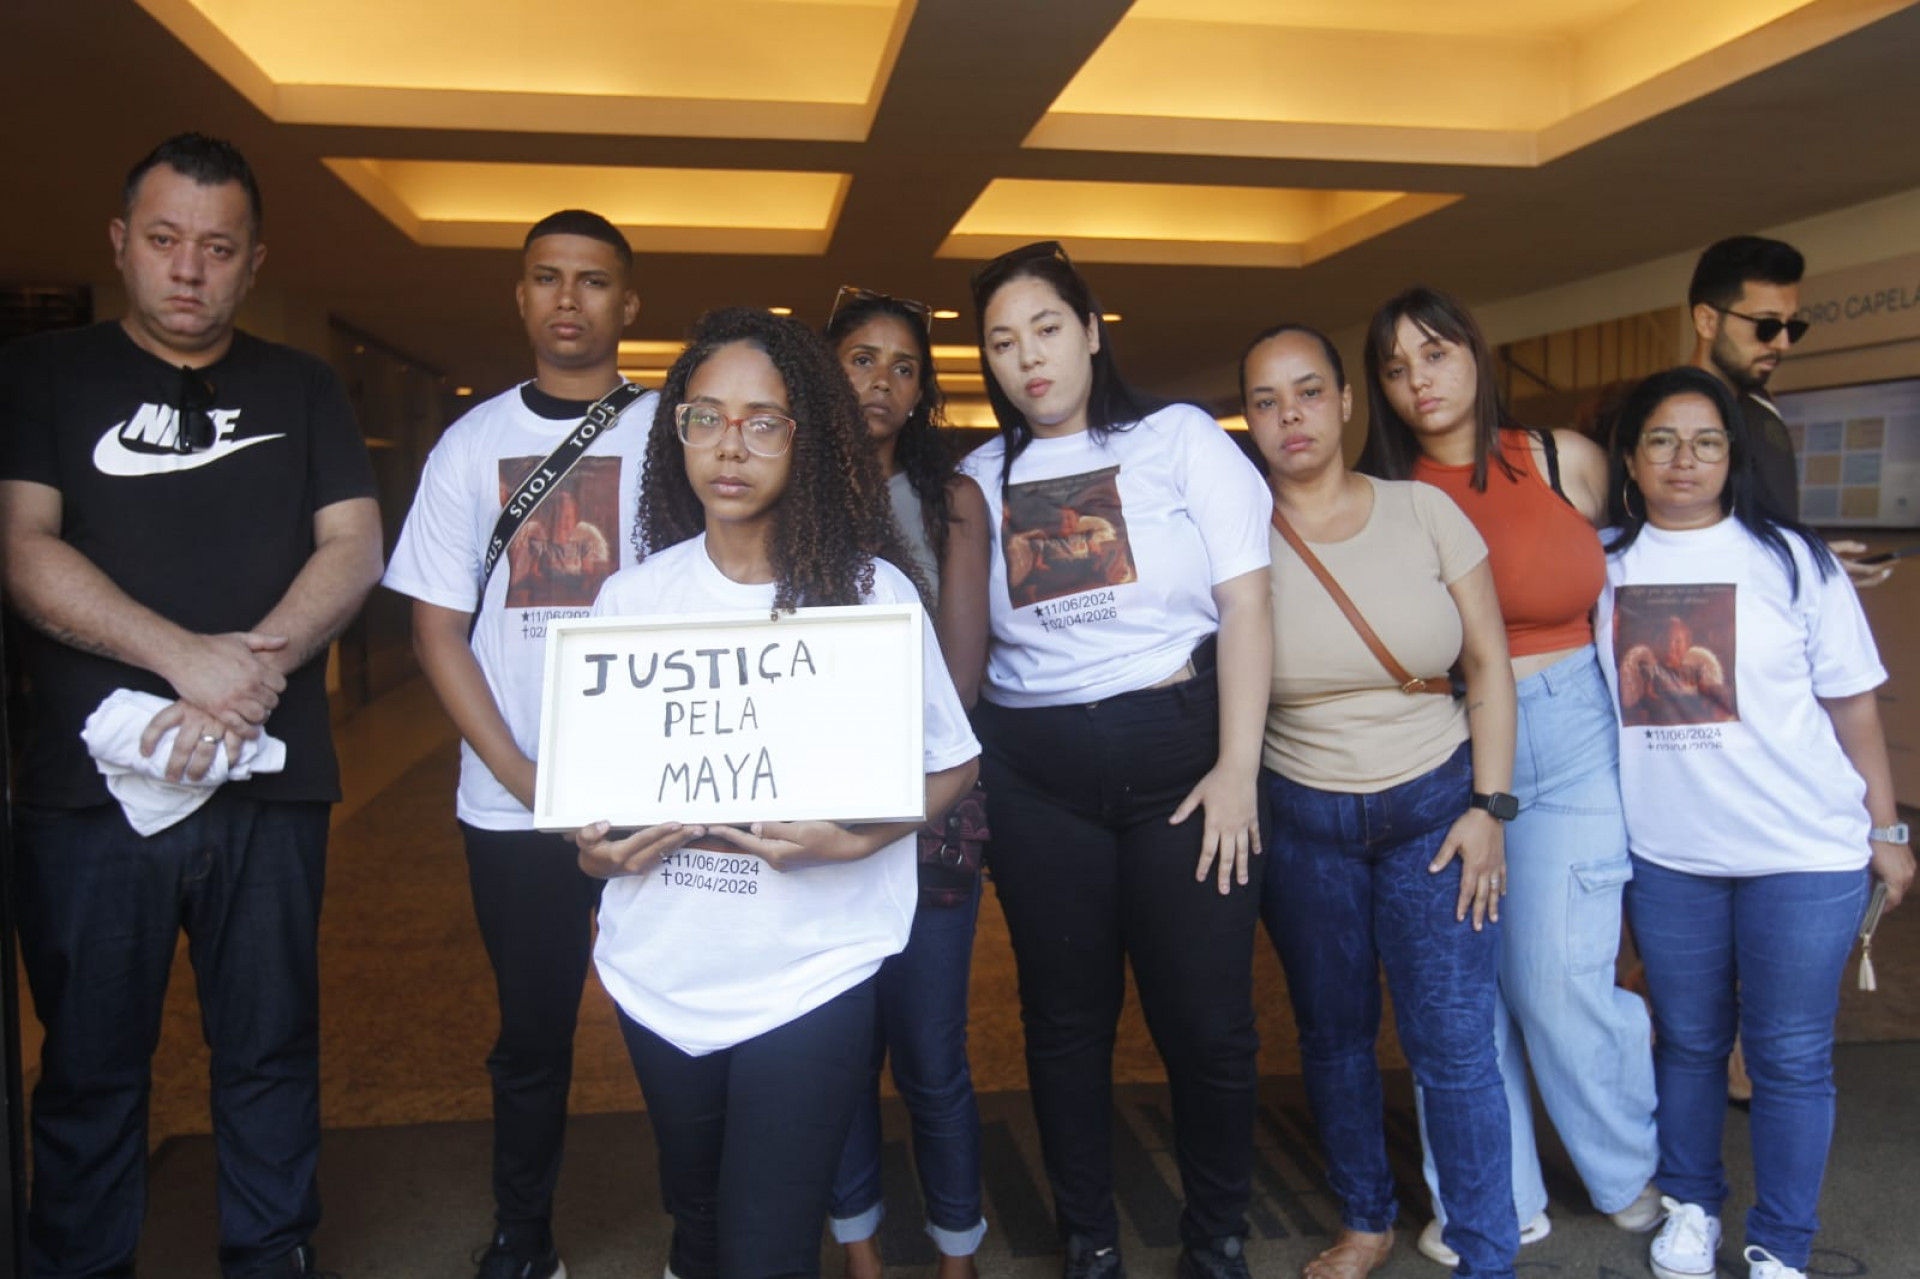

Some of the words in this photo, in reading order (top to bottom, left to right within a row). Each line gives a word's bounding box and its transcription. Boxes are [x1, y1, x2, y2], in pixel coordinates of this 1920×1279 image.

[121, 402, 242, 451] NIE
[509, 467, 558, 518] TOUS
[485, 535, 503, 574] OUS
[1044, 590, 1115, 617] 11/06/2024
[1049, 606, 1118, 630] 02/04/2026
[582, 639, 816, 696] JUSTIÇA
[664, 697, 758, 738] PELA
[658, 746, 778, 803] MAYA
[674, 871, 758, 895] 02/04/2026
[677, 854, 760, 876] 11/06/2024
